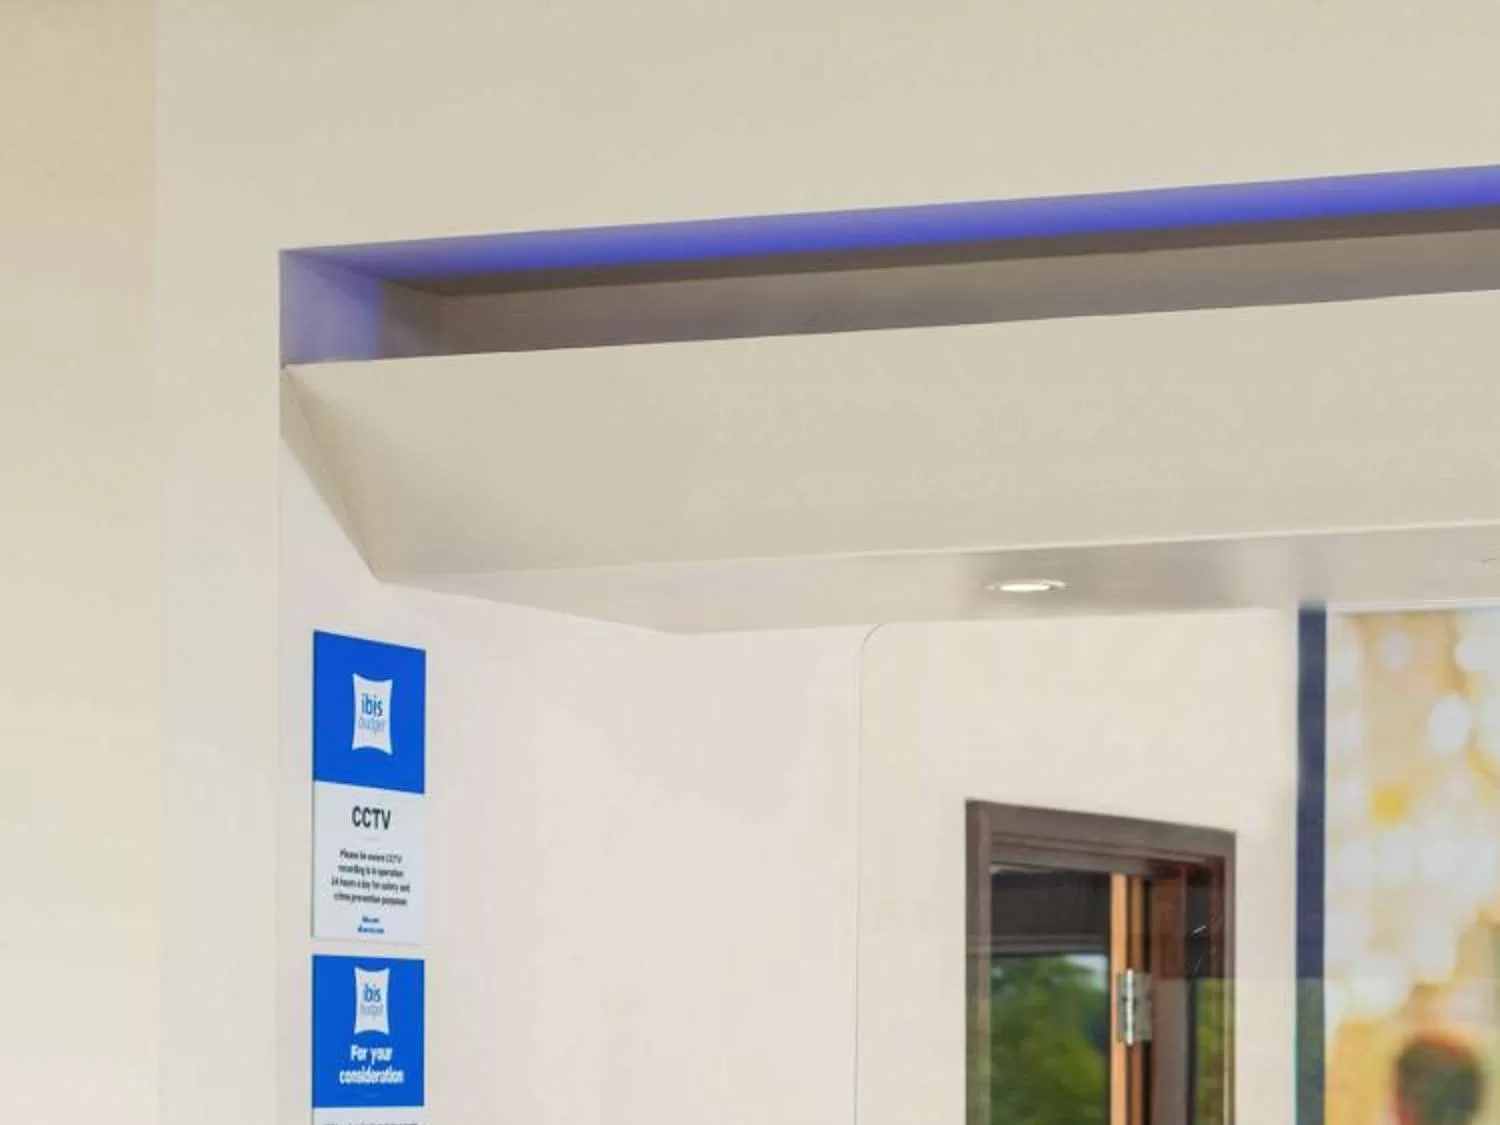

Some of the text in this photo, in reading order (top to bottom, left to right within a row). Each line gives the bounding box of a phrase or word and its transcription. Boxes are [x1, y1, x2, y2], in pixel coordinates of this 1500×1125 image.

[361, 692, 384, 717] ibis
[351, 805, 392, 830] CCTV
[351, 1044, 367, 1062] For
